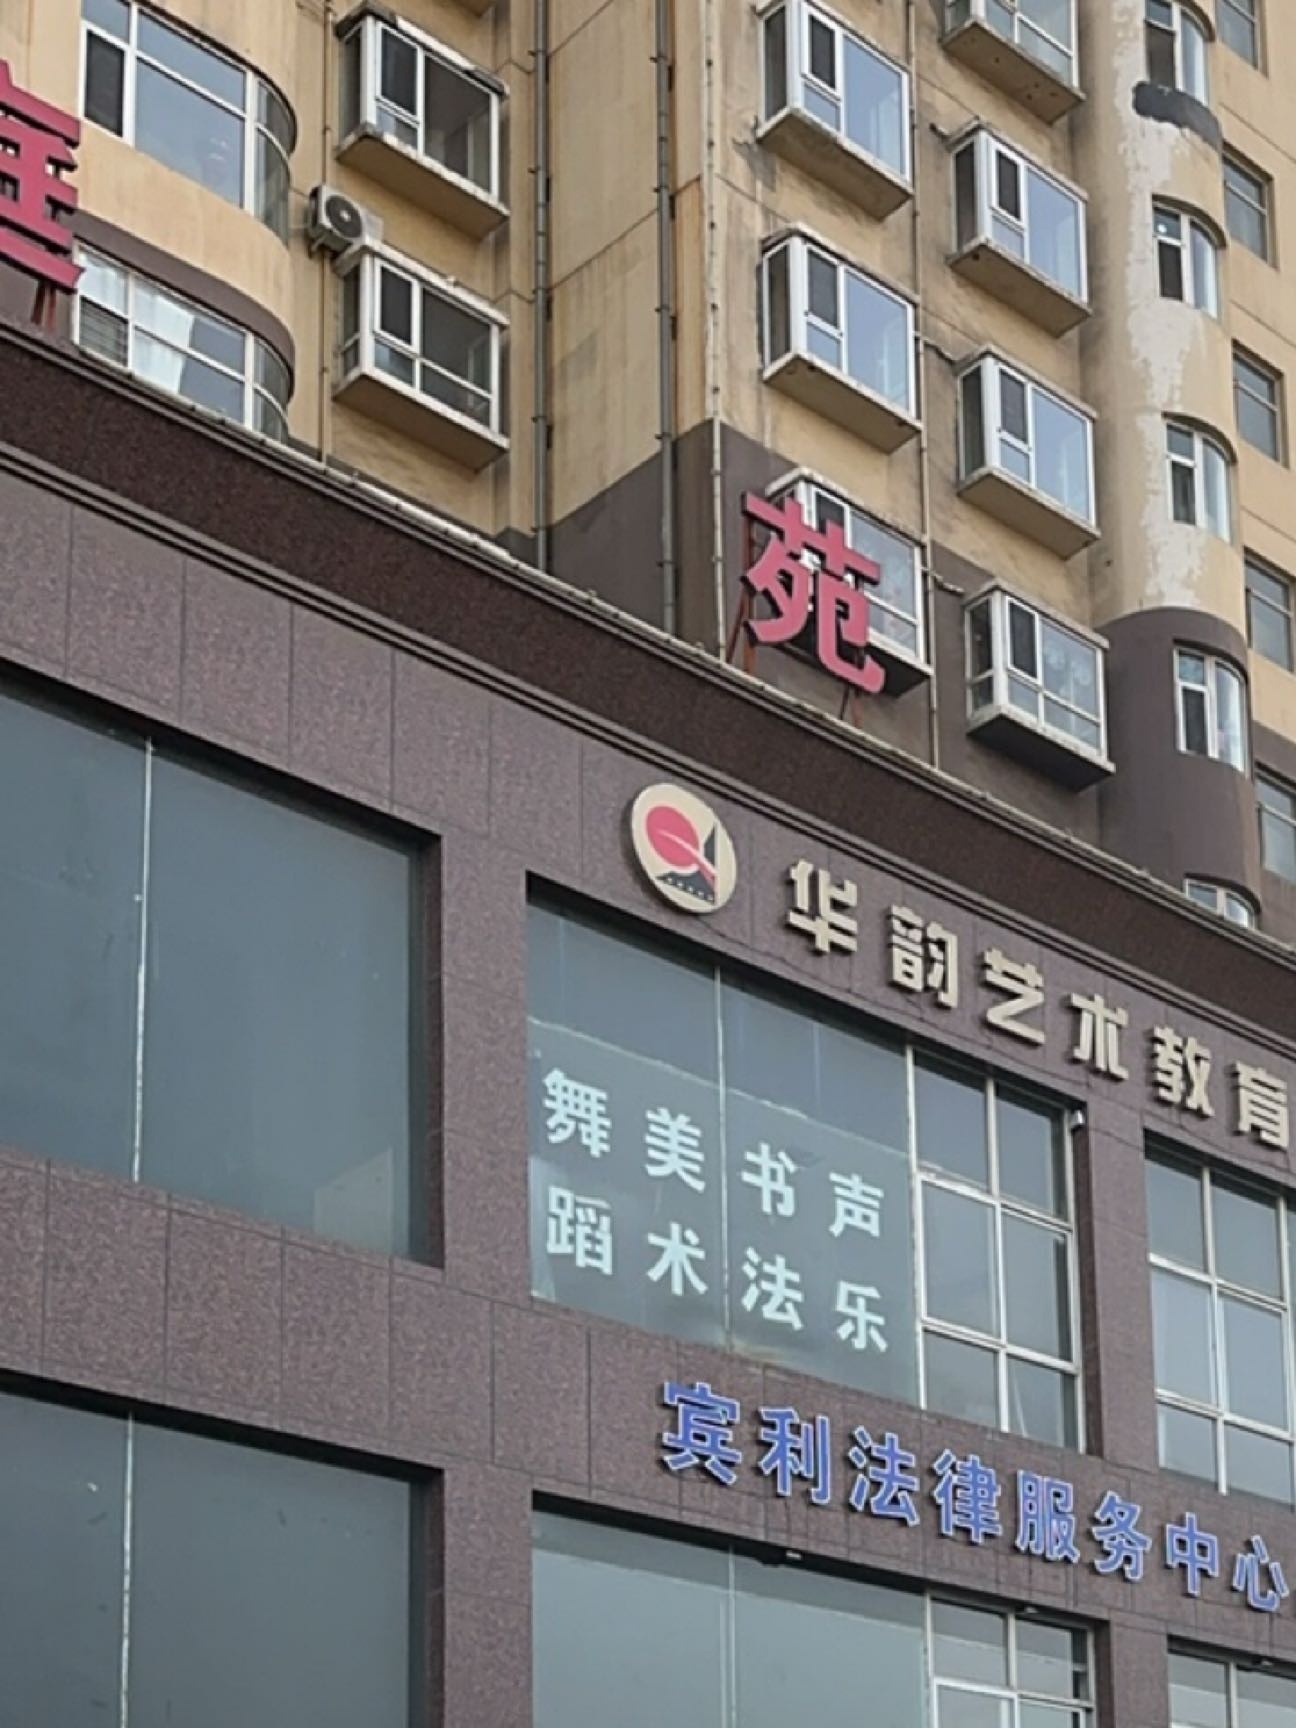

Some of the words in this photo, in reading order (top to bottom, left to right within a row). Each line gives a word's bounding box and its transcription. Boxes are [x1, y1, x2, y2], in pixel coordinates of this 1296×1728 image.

[743, 490, 884, 694] 苑
[785, 858, 1291, 1150] 华韵艺术教育
[661, 1380, 1292, 1614] 宾利法律服务中心
